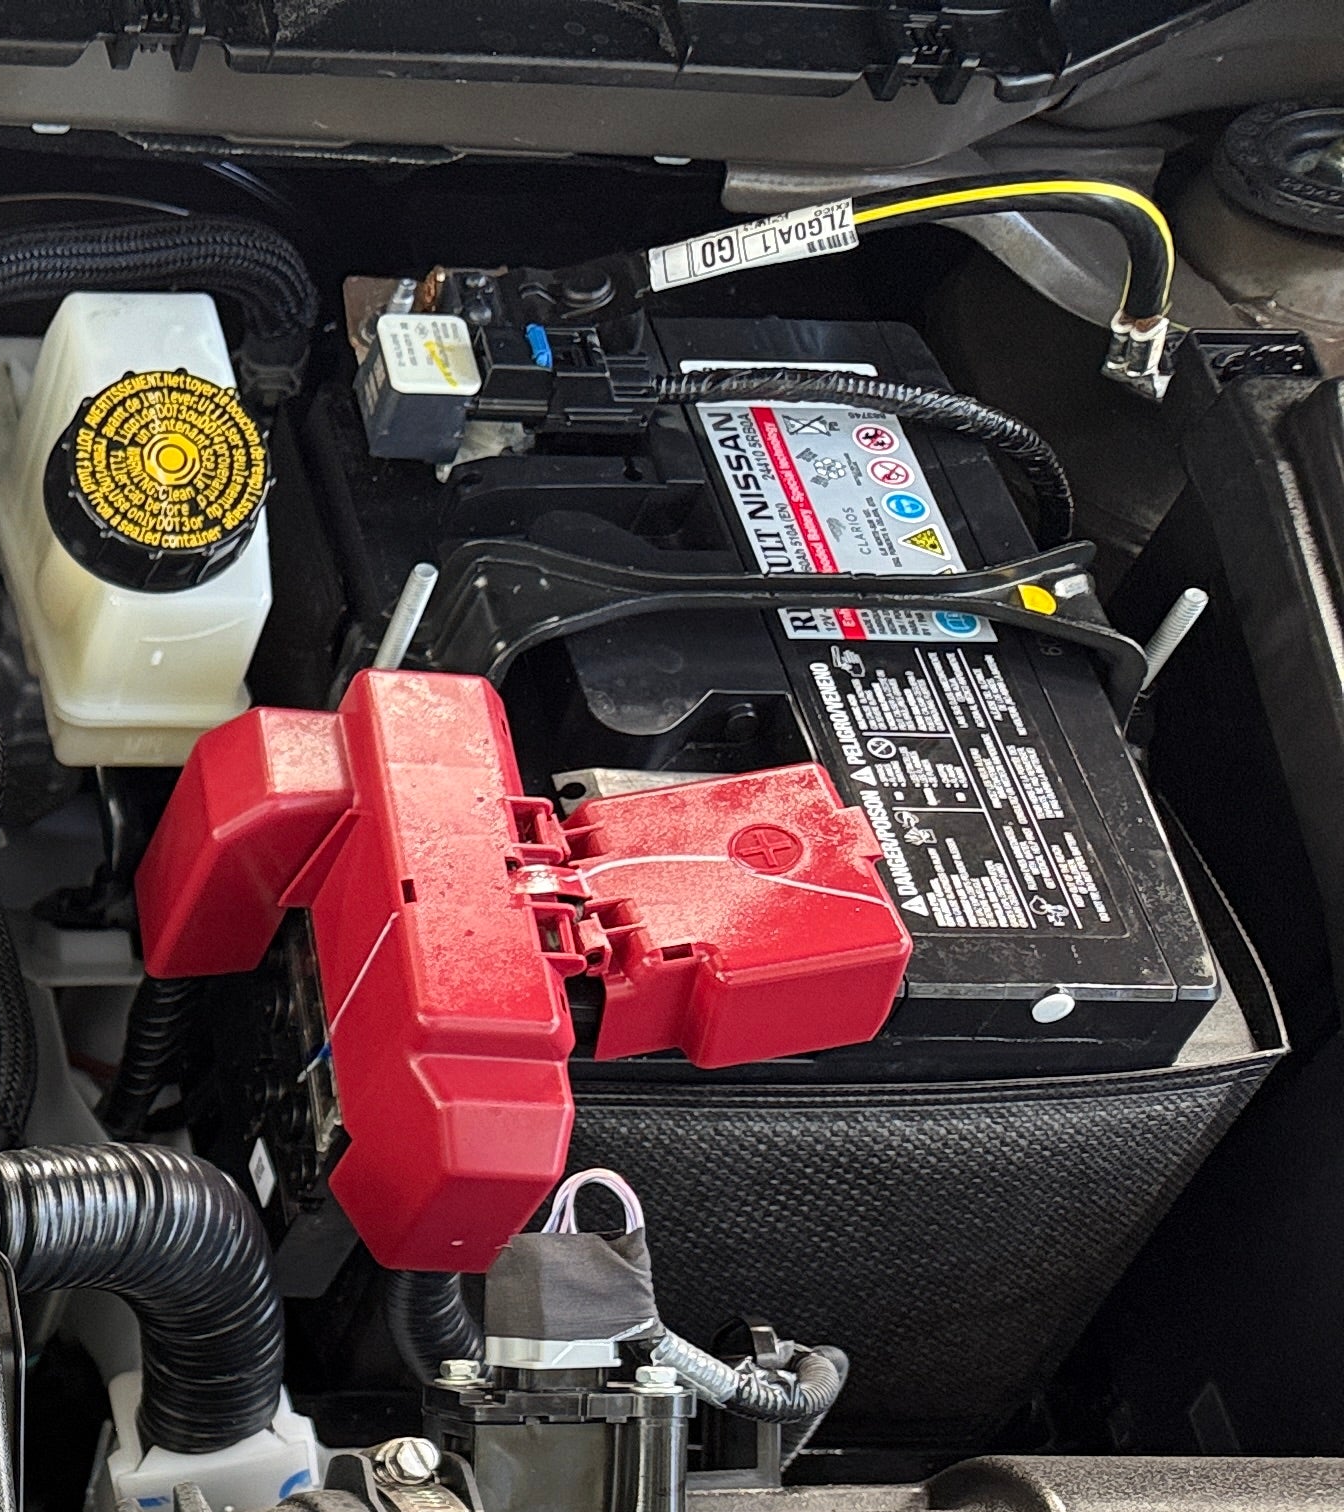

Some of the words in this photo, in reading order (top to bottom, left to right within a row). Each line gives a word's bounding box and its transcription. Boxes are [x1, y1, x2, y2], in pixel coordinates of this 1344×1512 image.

[706, 411, 775, 521] NISSAN
[841, 506, 872, 556] CLARIOS
[809, 661, 868, 766] PELIGRO/VENENO
[863, 790, 919, 897] DANGER/POISON
